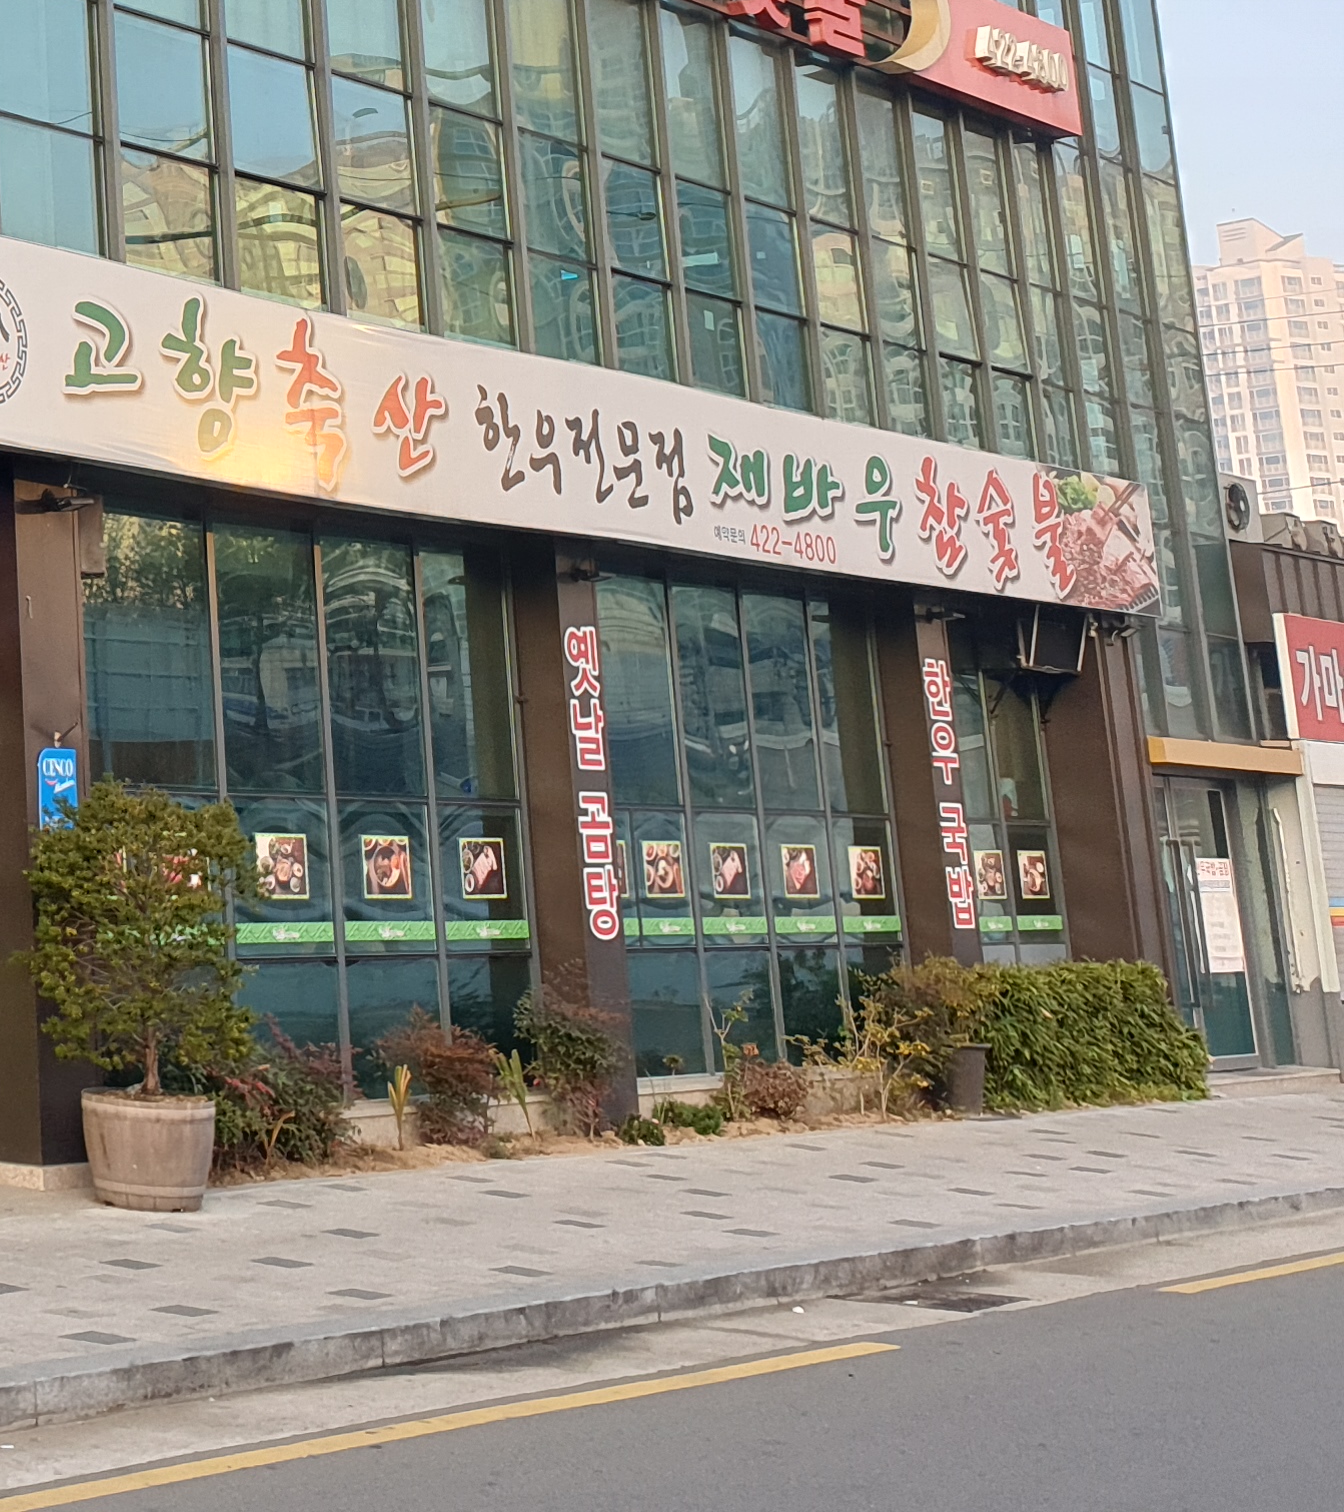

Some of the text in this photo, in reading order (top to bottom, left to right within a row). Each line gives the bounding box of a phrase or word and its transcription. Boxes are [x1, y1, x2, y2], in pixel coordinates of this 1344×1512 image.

[475, 384, 694, 524] 한우전문점
[706, 433, 900, 561] 재바우
[915, 454, 1078, 602] 참숯불
[713, 522, 838, 566] 예약문의 422-4800
[564, 626, 620, 941] 옛날 곰탕
[922, 658, 976, 930] 한우 국밥
